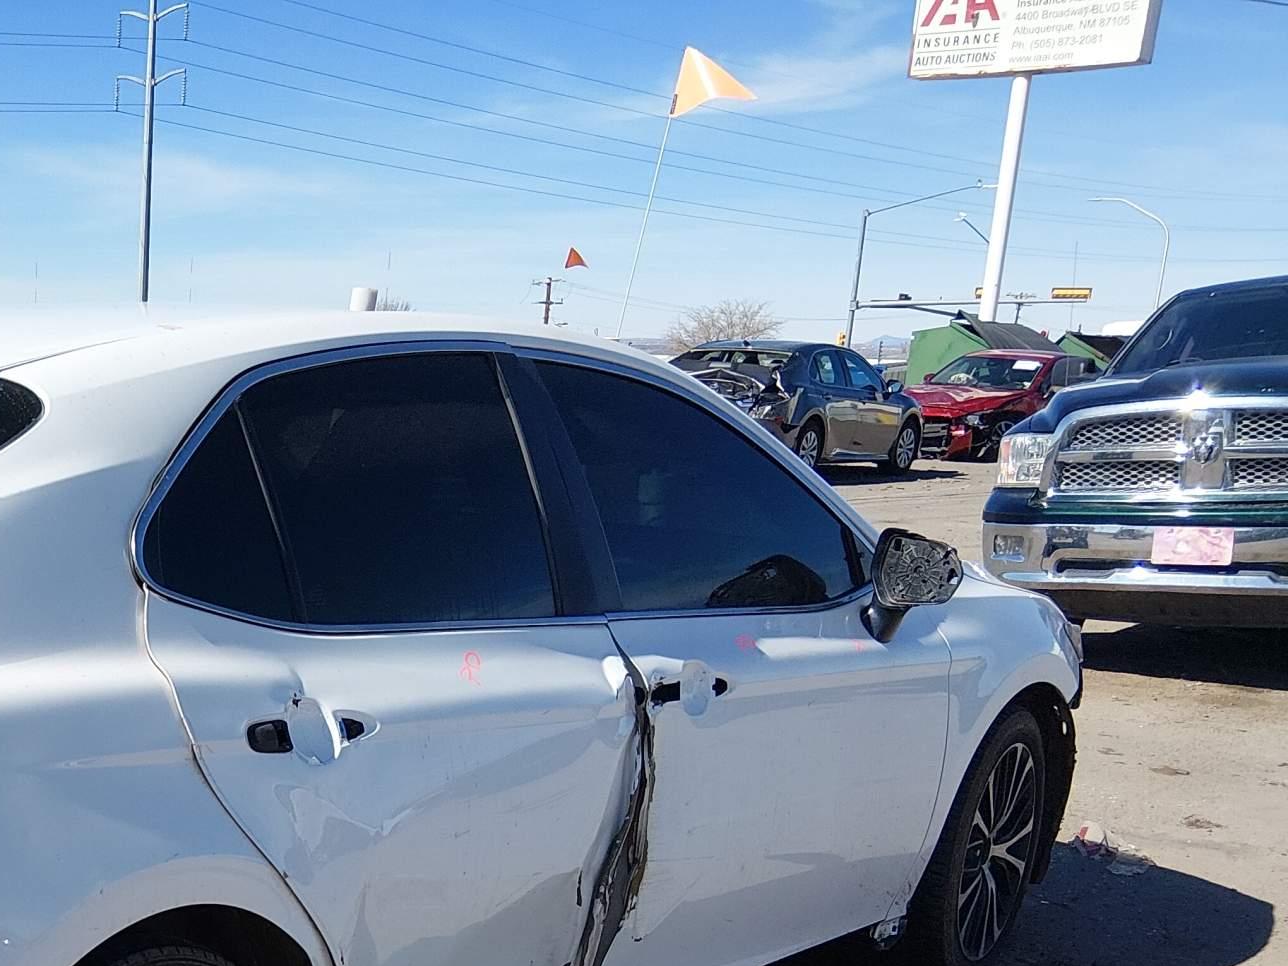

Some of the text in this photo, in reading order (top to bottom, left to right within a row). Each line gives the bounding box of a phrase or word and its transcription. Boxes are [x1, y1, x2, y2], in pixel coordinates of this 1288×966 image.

[1015, 11, 1039, 21] 4400
[1123, 0, 1138, 11] SE
[1079, 18, 1097, 29] NM
[1098, 14, 1131, 28] 87105
[917, 32, 1000, 49] INSURANCE
[914, 51, 997, 67] AUTO AUCTIONS
